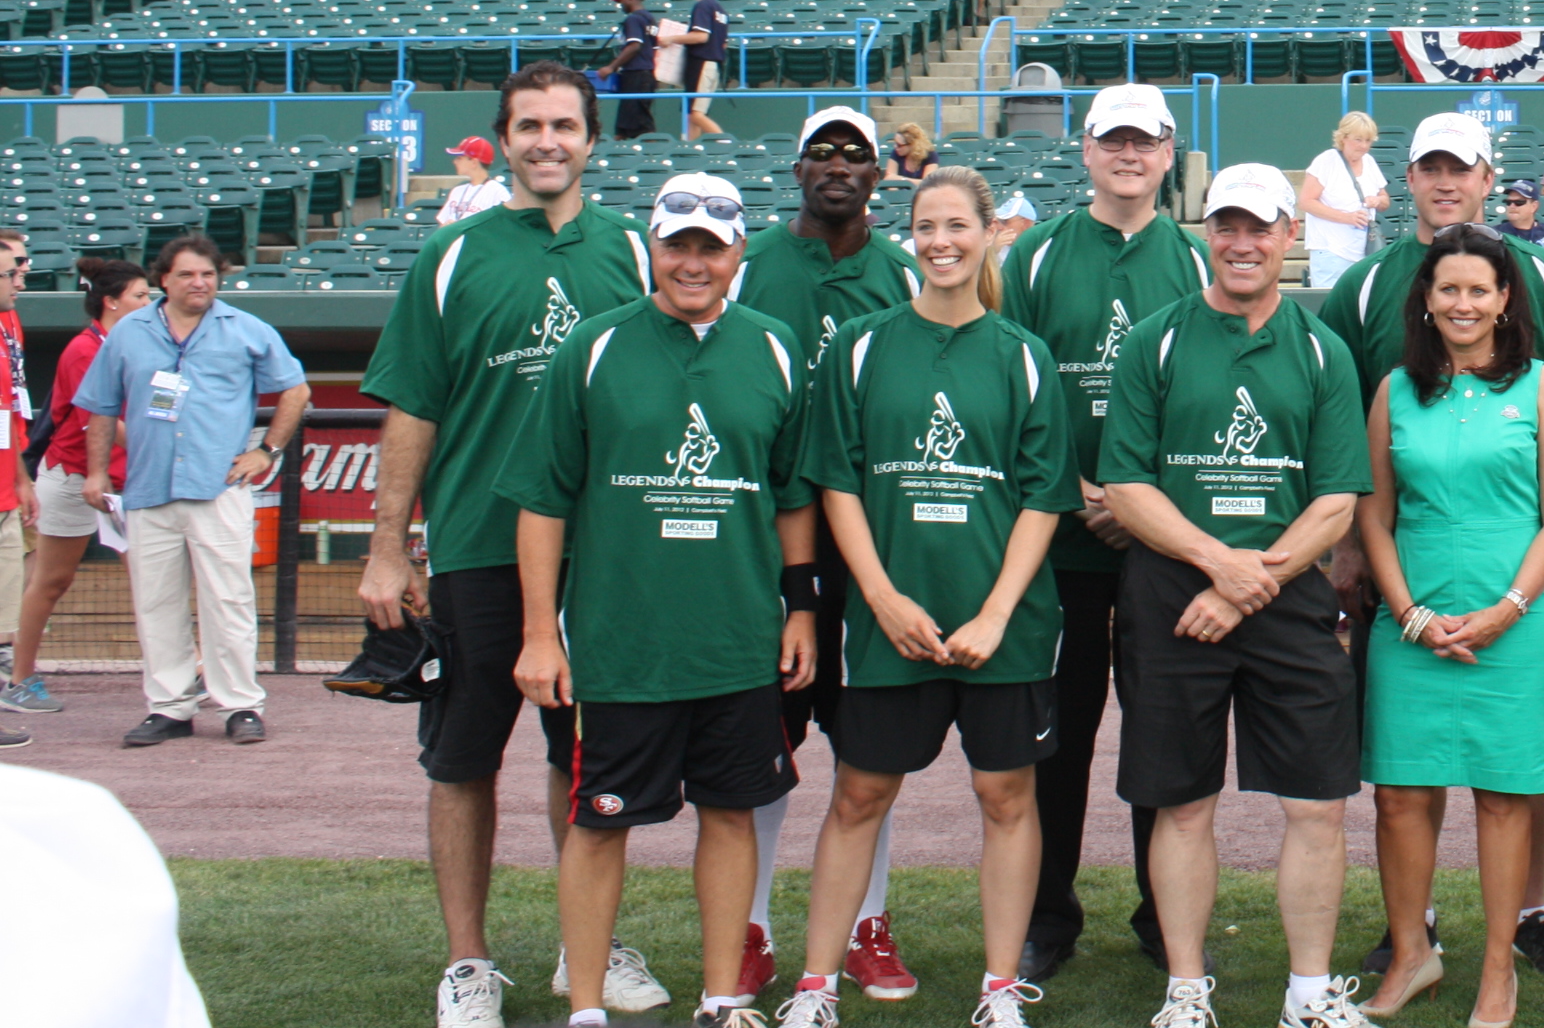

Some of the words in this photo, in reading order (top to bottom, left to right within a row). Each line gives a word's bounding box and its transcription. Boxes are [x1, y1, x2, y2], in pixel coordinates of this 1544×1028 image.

[1464, 110, 1512, 122] SECTON
[487, 346, 543, 367] LEGENDS
[1167, 454, 1224, 465] LEGENDS
[873, 461, 925, 474] LEGENDS
[611, 474, 676, 487] LEGENDS
[1195, 473, 1229, 482] Celebrity
[1230, 474, 1258, 482] Softball
[1259, 475, 1283, 483] Game
[899, 480, 930, 489] Celebrity
[930, 481, 959, 490] Softball
[960, 483, 984, 492] Game
[643, 495, 681, 505] Celebrity
[681, 495, 711, 505] Softball
[713, 497, 735, 505] Game
[1215, 500, 1262, 508] MODELL'S
[917, 506, 964, 515] MODELL'S
[665, 522, 714, 531] MODELL'S
